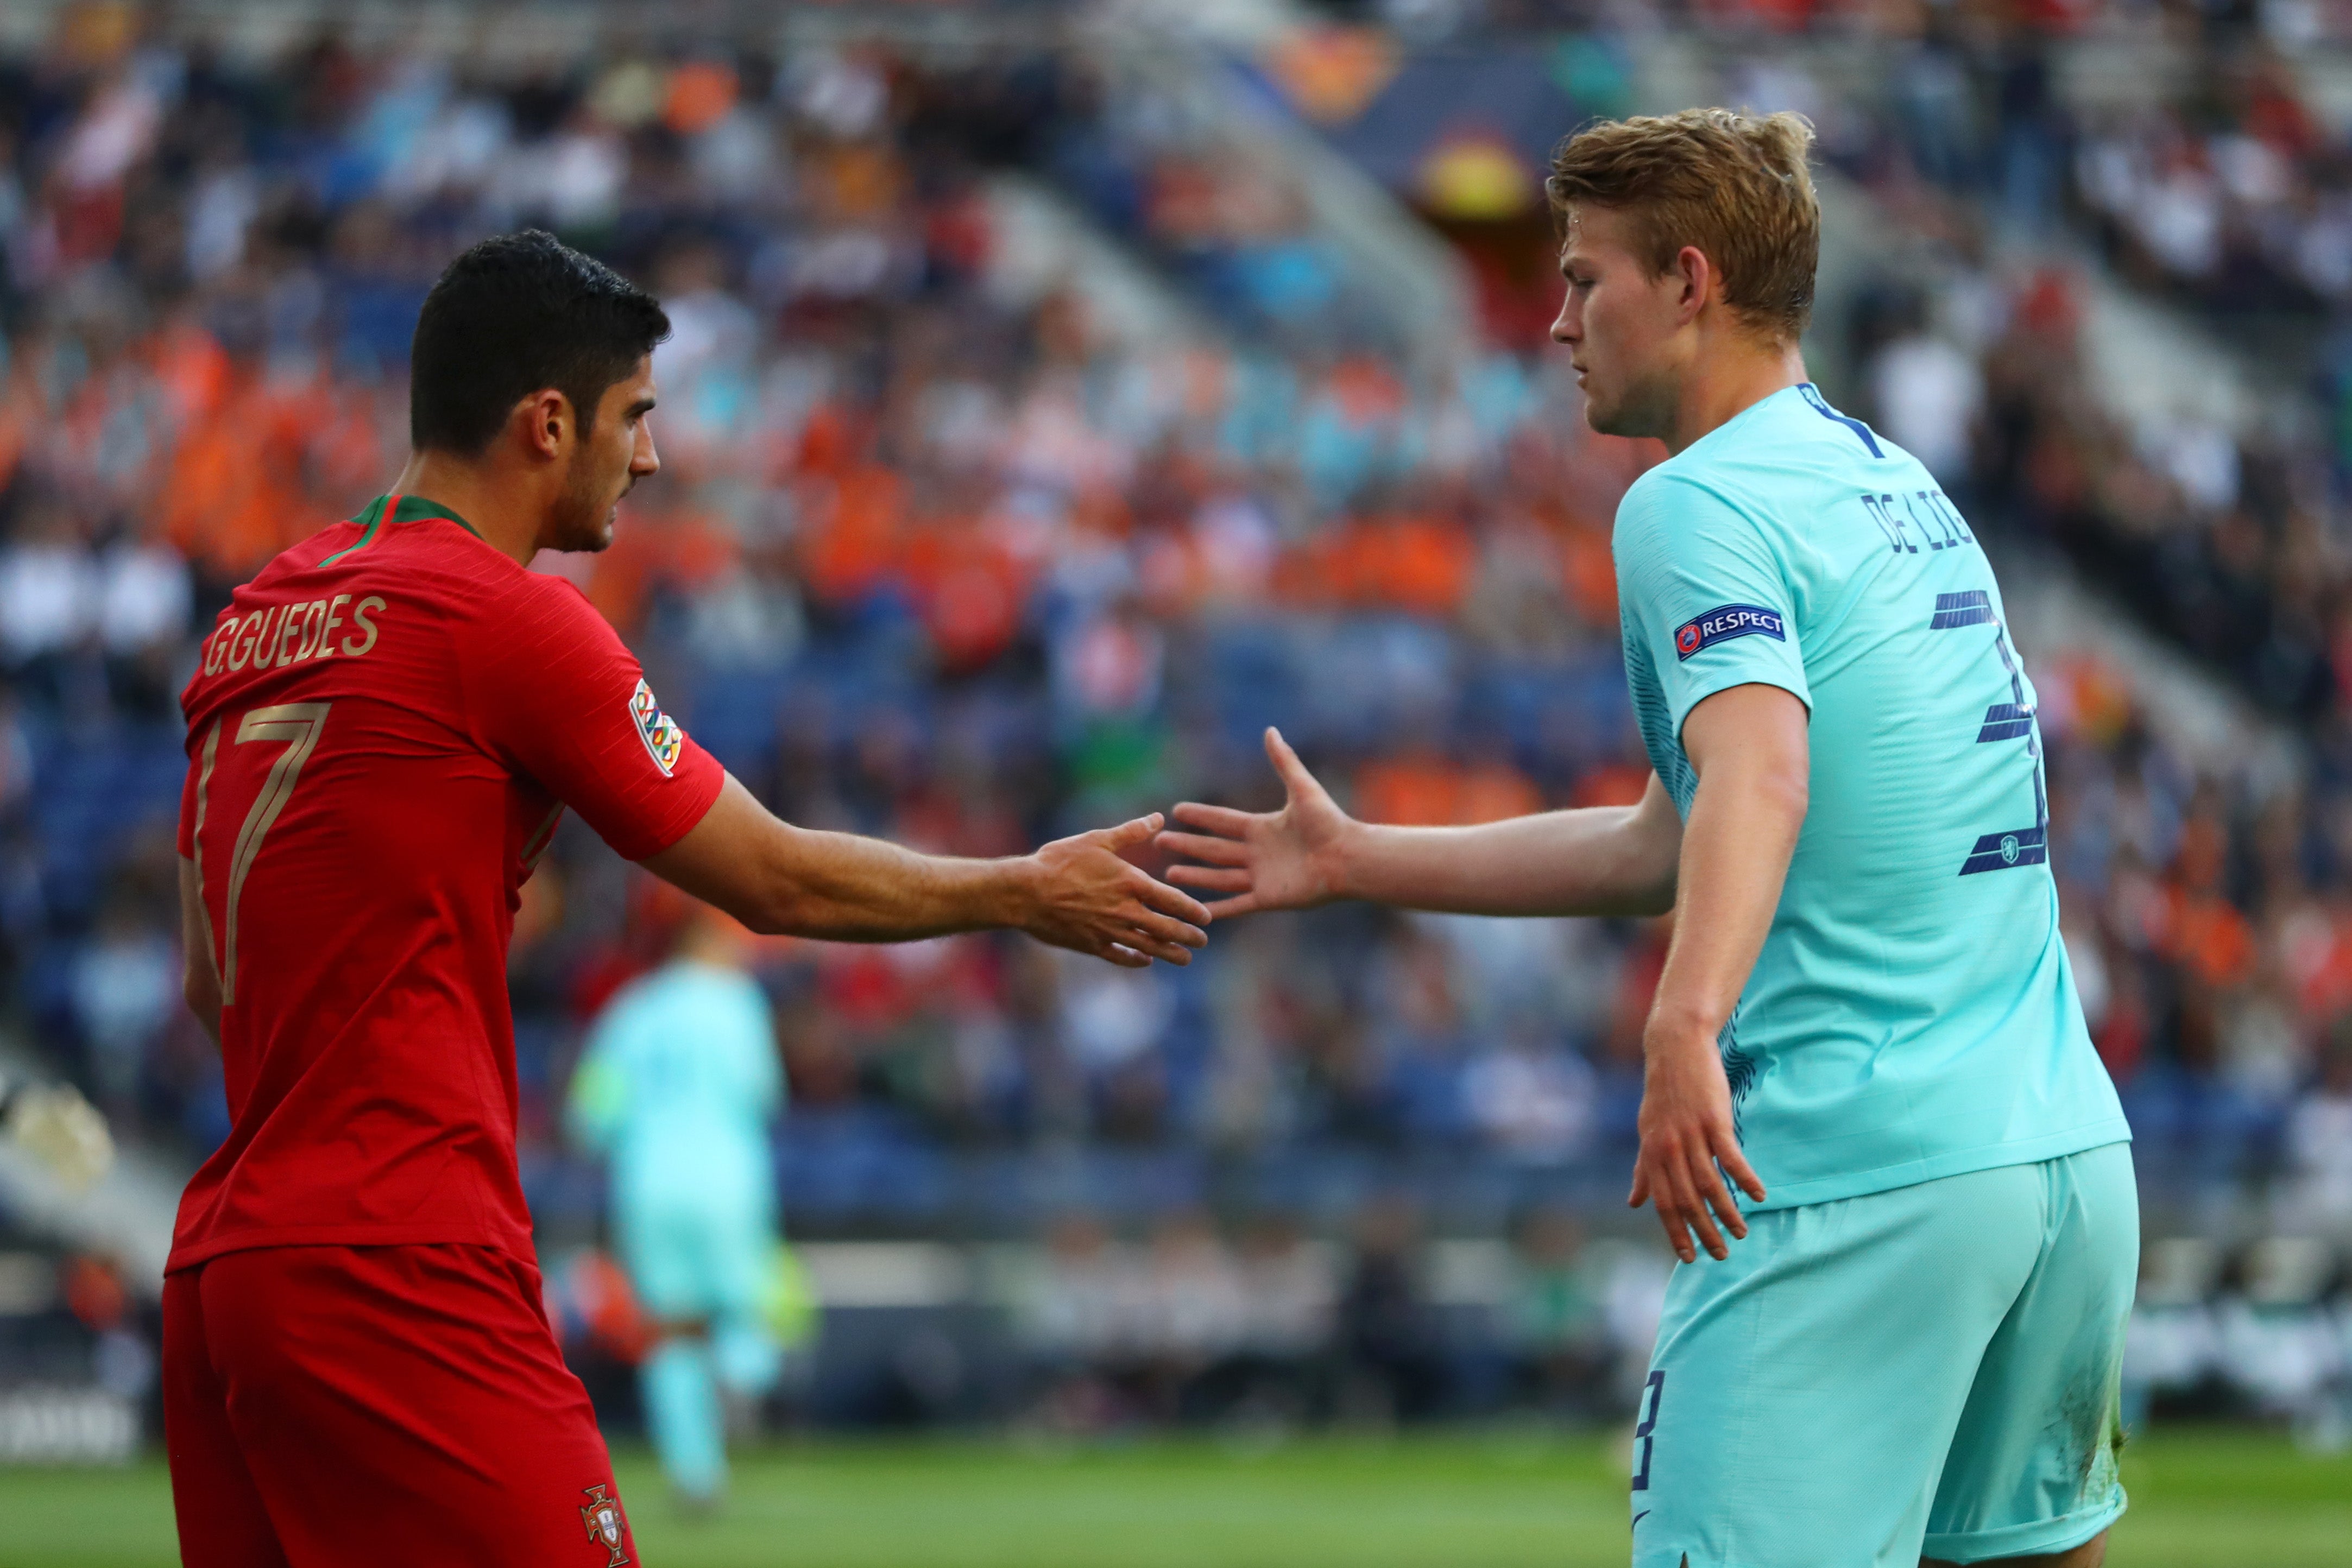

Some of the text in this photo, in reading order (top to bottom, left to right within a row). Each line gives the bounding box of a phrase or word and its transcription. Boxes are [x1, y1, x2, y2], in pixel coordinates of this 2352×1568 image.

[1861, 494, 1918, 553] DE
[1702, 612, 1781, 637] RESPECT
[1930, 590, 2050, 876] 3
[194, 703, 332, 1006] 17
